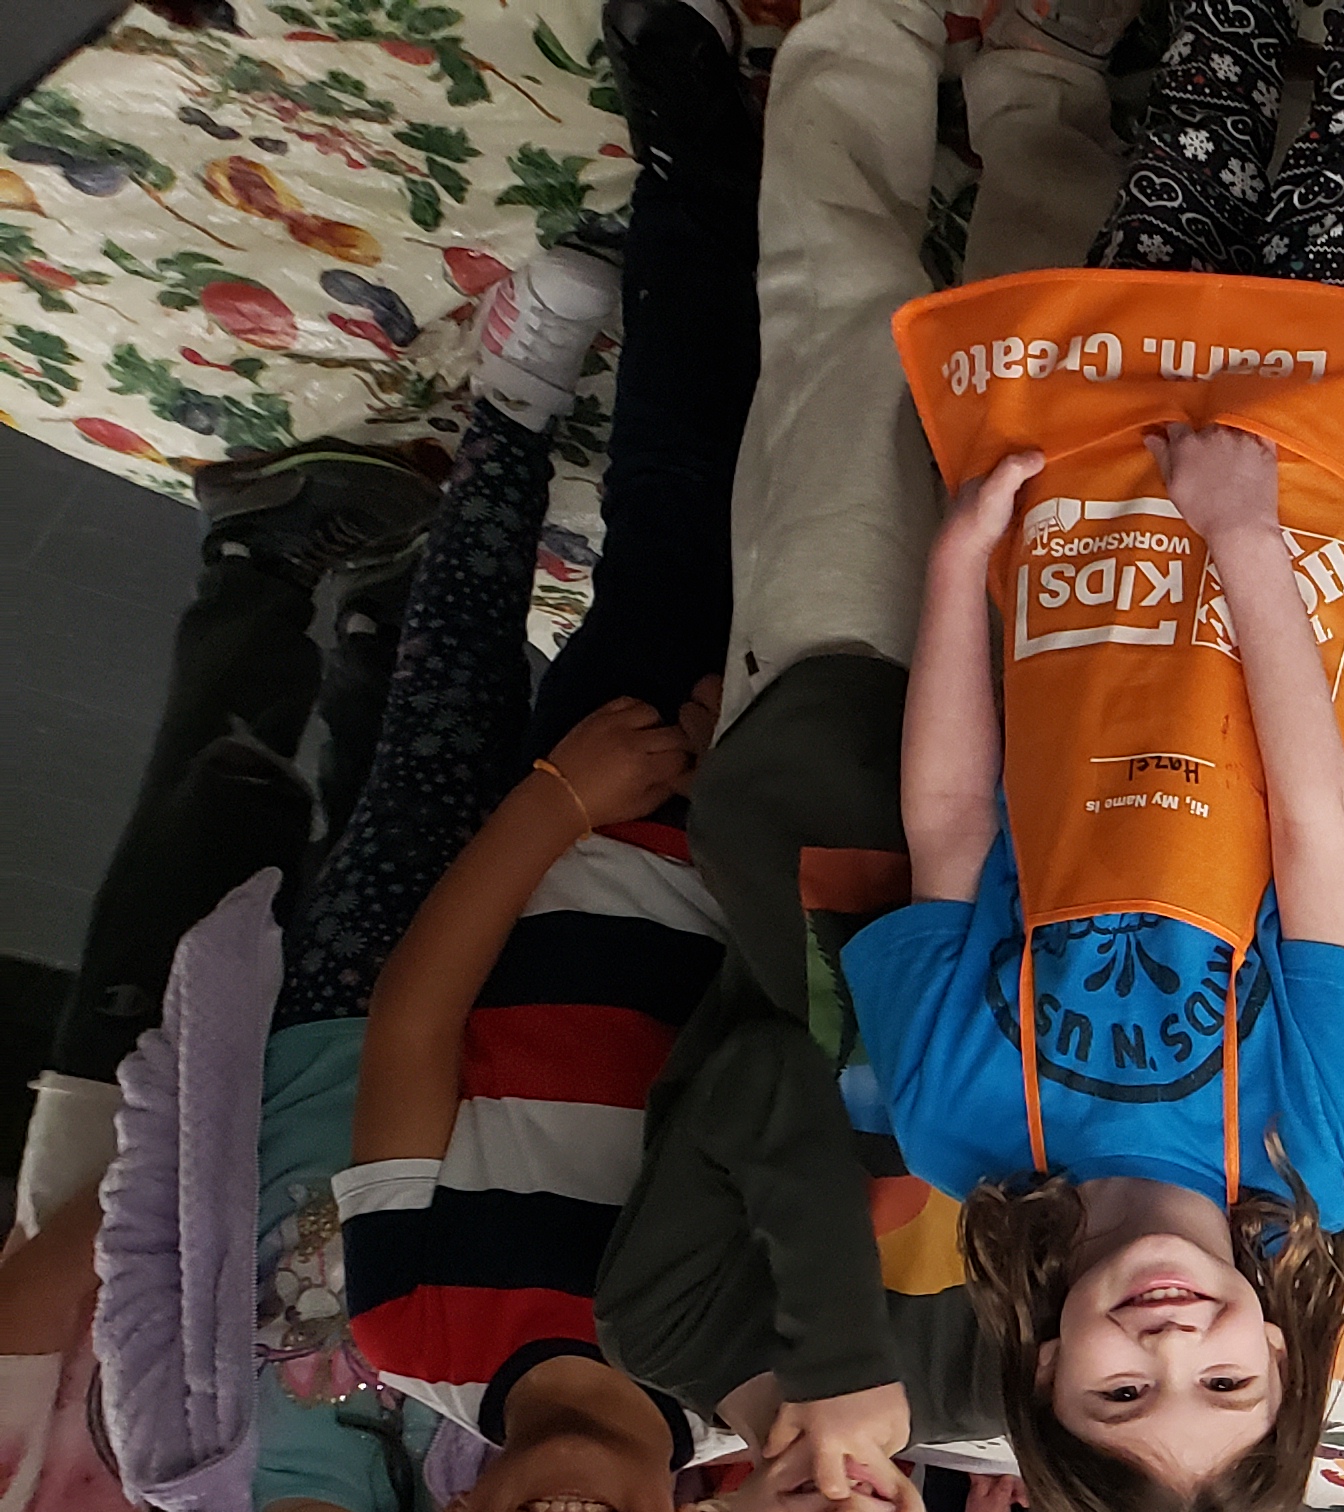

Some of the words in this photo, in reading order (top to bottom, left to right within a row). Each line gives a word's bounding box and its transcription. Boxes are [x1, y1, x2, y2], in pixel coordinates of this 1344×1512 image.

[941, 333, 1123, 397] Create.
[1142, 337, 1327, 385] Learn.
[1050, 530, 1191, 557] WORKSHOPS
[1038, 558, 1182, 611] KIDS
[1128, 756, 1199, 784] Hazel
[1104, 794, 1147, 809] Name
[1151, 791, 1179, 810] My
[1185, 795, 1209, 818] Hi,
[1159, 945, 1252, 1063] KIDS
[1034, 993, 1093, 1063] US
